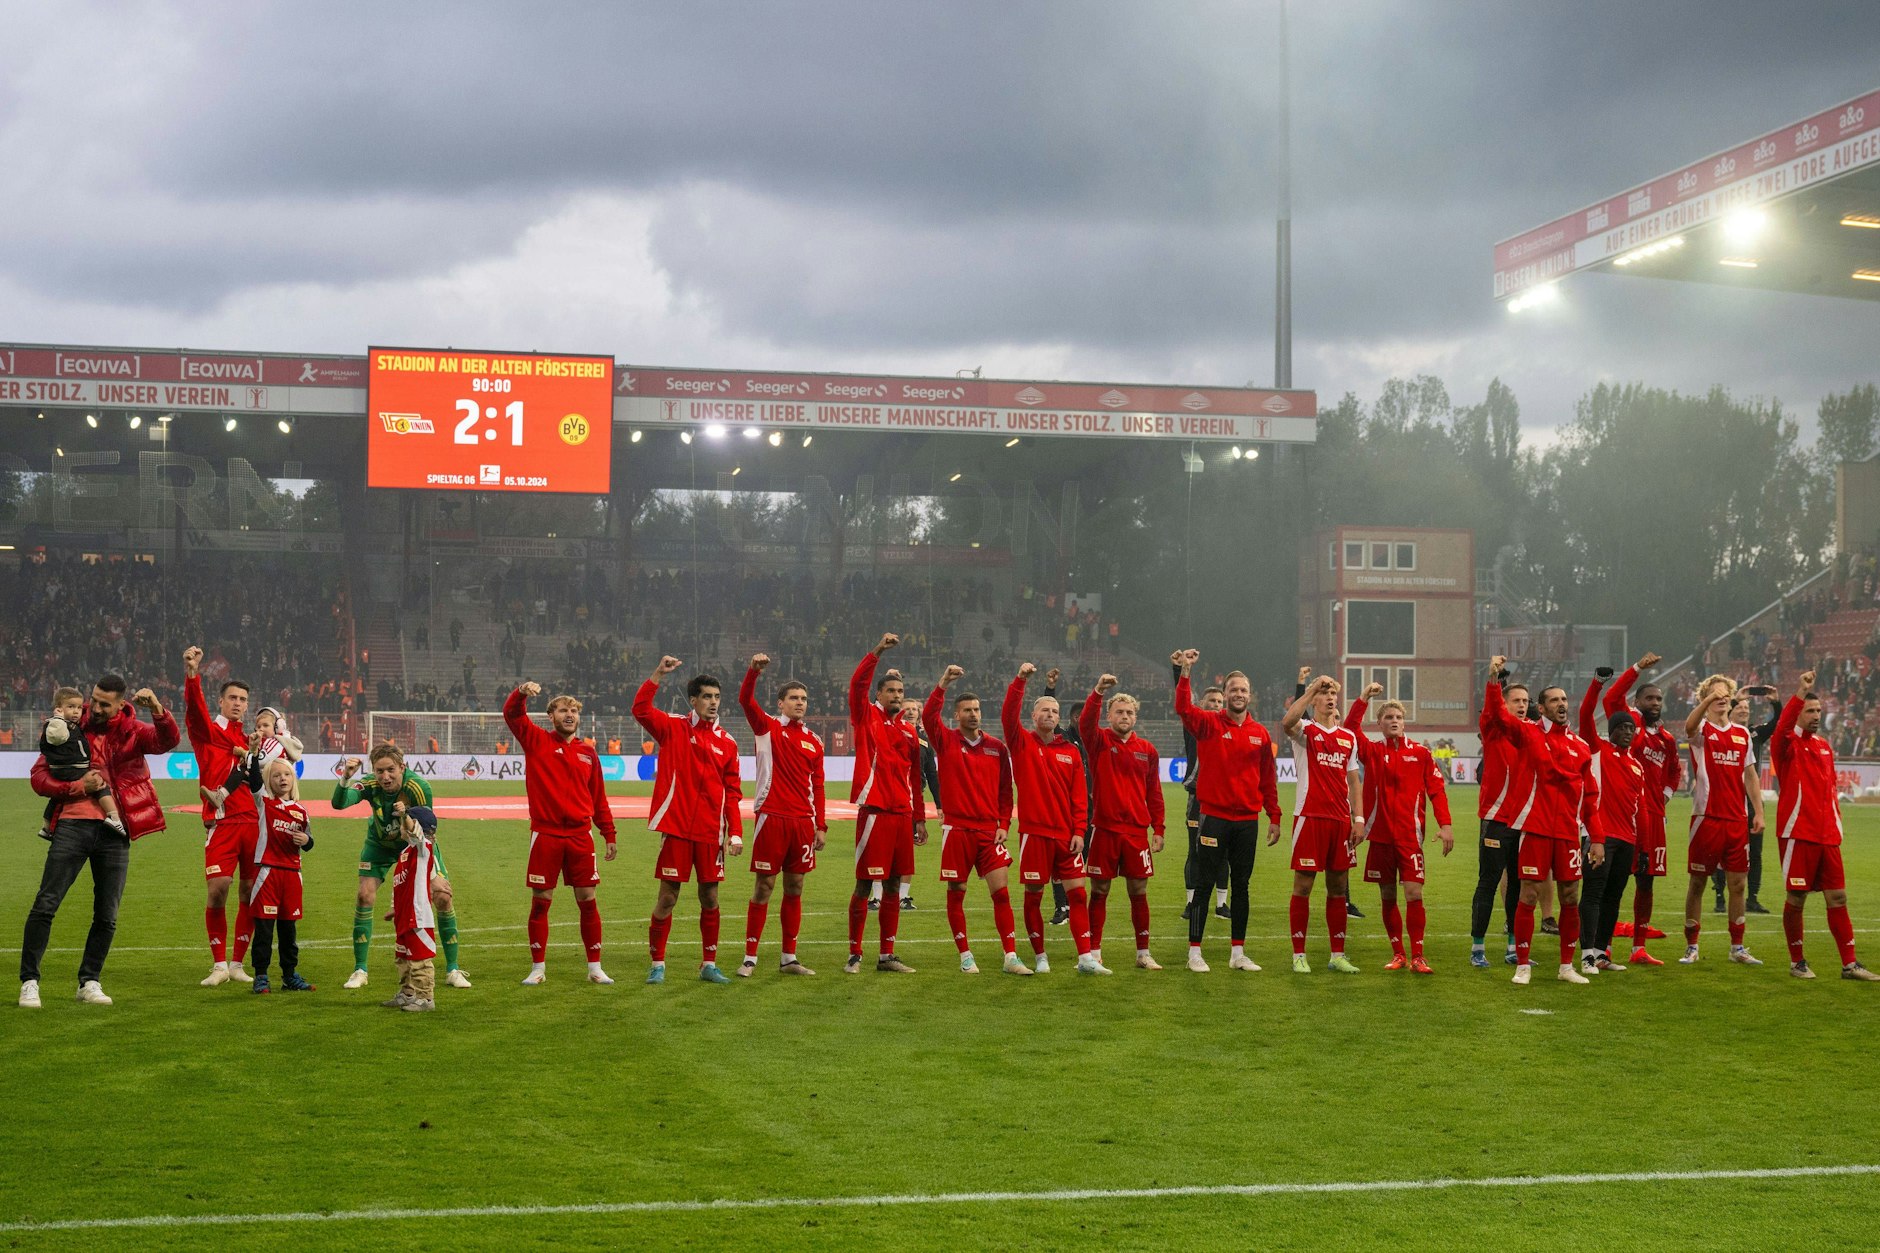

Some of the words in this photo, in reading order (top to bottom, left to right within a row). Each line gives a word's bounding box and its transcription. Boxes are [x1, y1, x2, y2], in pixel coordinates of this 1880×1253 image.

[1840, 106, 1864, 128] a&o
[1795, 124, 1819, 145] a&o
[1754, 140, 1776, 161] a&o
[1714, 156, 1736, 178] a&o
[1677, 171, 1698, 192] a&o
[1606, 231, 1624, 253] AUF
[1629, 216, 1661, 245] EINER
[1665, 199, 1710, 231] GRÜNEN
[1757, 169, 1786, 198] ZWEI
[1793, 154, 1826, 185] TORE
[1833, 134, 1880, 170] AUFGE
[320, 369, 360, 378] AMPELMANN
[377, 355, 436, 372] STADION
[438, 357, 458, 373] AN
[461, 358, 488, 374] DER
[490, 359, 533, 376] ALTEN
[535, 359, 605, 378] FÖRSTEREI
[26, 381, 87, 401] STOLZ.
[98, 384, 158, 404] UNSER
[164, 386, 235, 406] VEREIN.
[472, 378, 511, 393] 90:00
[666, 377, 715, 393] Seeger
[746, 379, 794, 396] Seeger
[824, 382, 873, 399] Seeger
[902, 384, 950, 401] Seeger
[454, 398, 524, 446] 2:1
[563, 417, 586, 435] BVB
[690, 402, 755, 421] UNSERE
[760, 404, 811, 422] LIEBE.
[818, 405, 881, 425] UNSERE
[887, 407, 1001, 429] MANNSCHAFT.
[1007, 411, 1059, 430] UNSER
[1063, 414, 1115, 433] STOLZ.
[1122, 416, 1174, 434] UNSER
[1180, 417, 1239, 436] VEREIN.
[427, 474, 463, 485] SPIELTAG
[464, 475, 476, 485] 06
[504, 476, 548, 487] 05.10.2024
[1316, 752, 1346, 764] proAF
[1139, 848, 1152, 868] 16
[1410, 853, 1424, 871] 13
[1569, 848, 1582, 868] 28
[1655, 847, 1666, 864] 17
